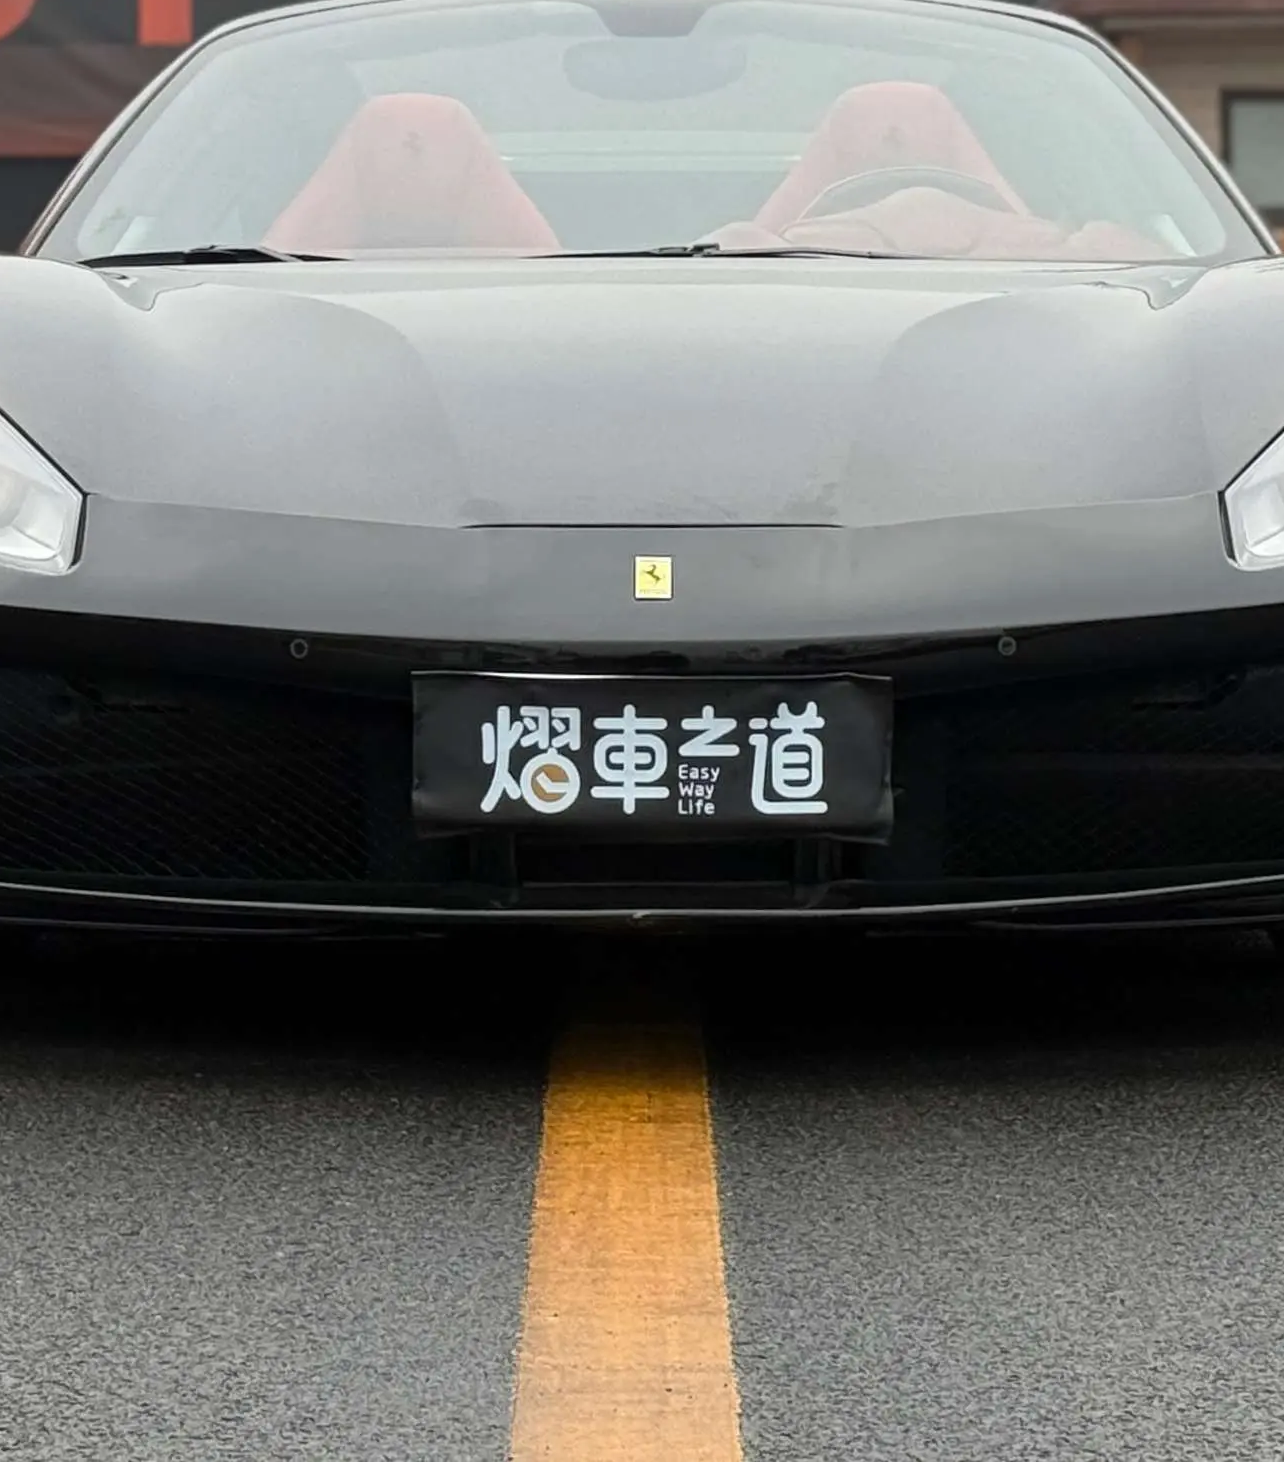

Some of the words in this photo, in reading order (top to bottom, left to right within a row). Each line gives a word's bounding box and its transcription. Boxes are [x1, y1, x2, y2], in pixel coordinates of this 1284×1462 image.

[678, 763, 721, 783] Easy
[678, 781, 715, 800] Way
[678, 798, 716, 816] Life
